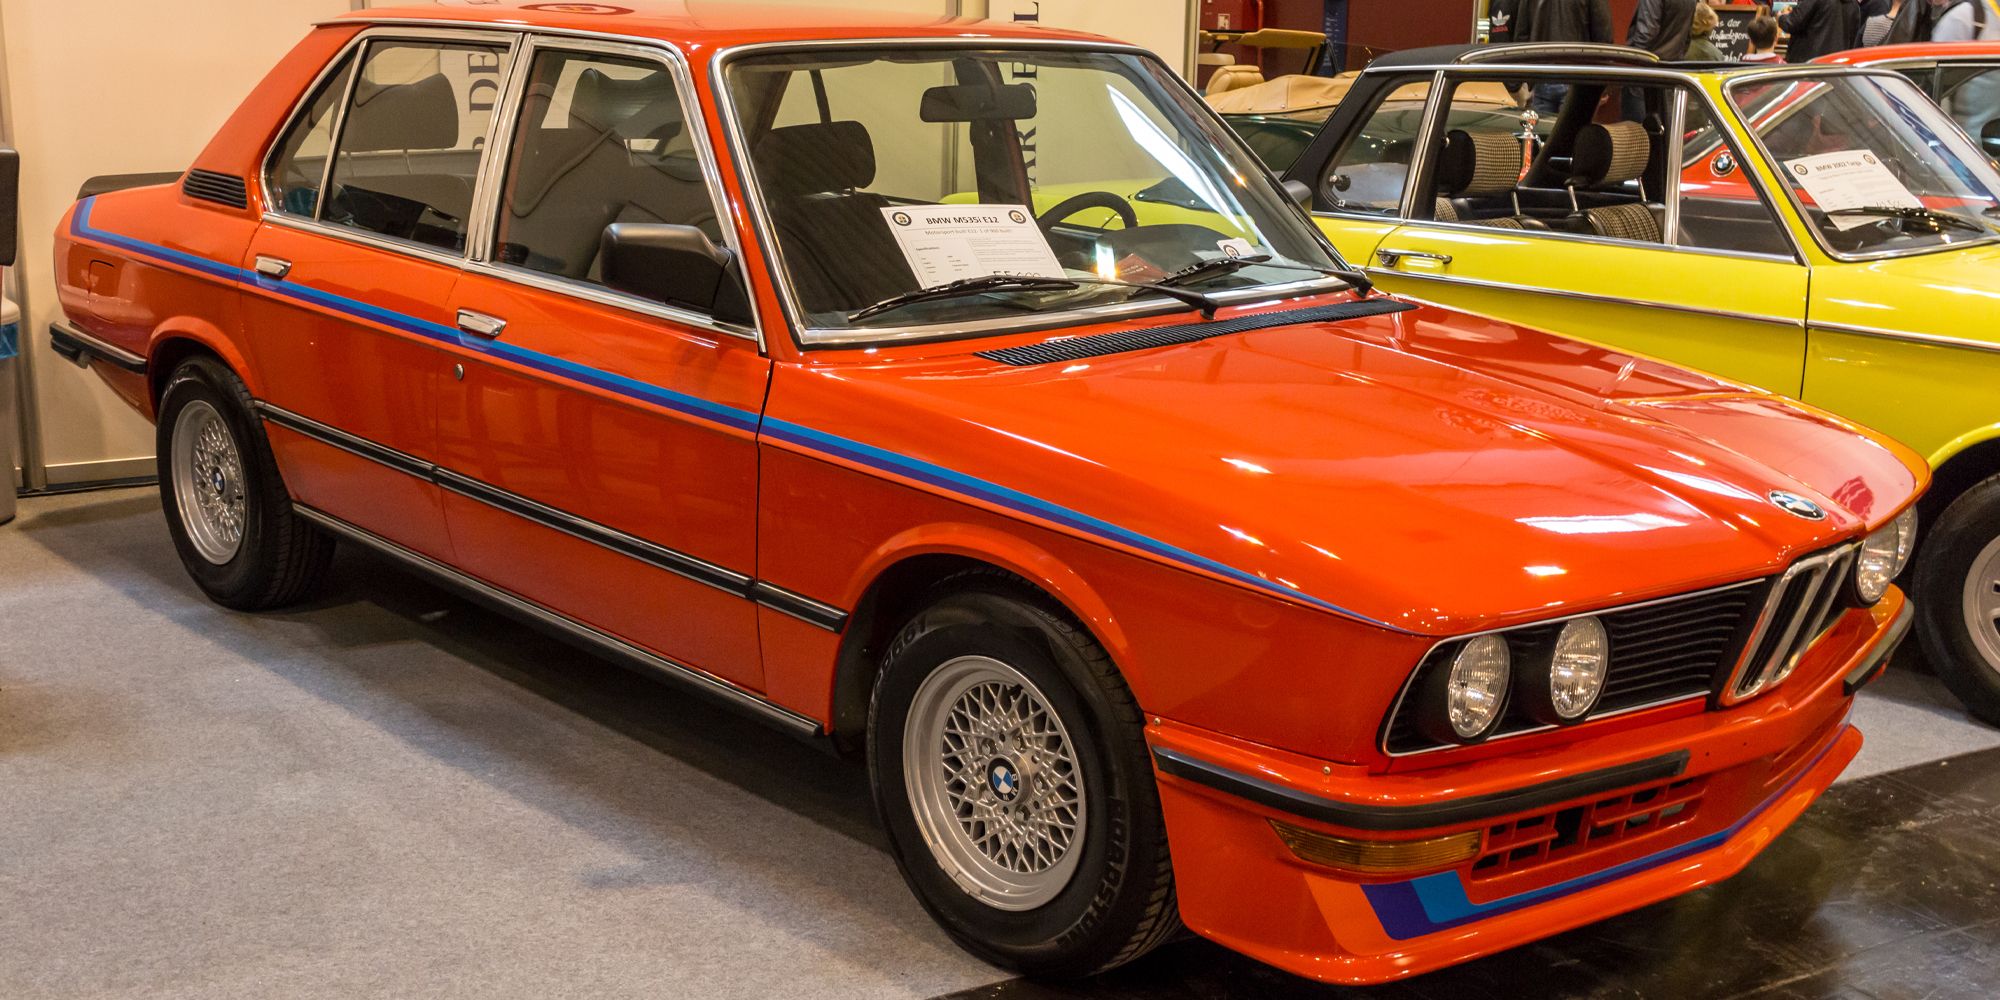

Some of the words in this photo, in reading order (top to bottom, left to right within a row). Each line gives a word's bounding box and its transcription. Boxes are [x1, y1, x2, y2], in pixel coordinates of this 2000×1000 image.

[925, 216, 952, 225] BMW
[953, 216, 981, 224] M535i
[983, 216, 1000, 224] E12
